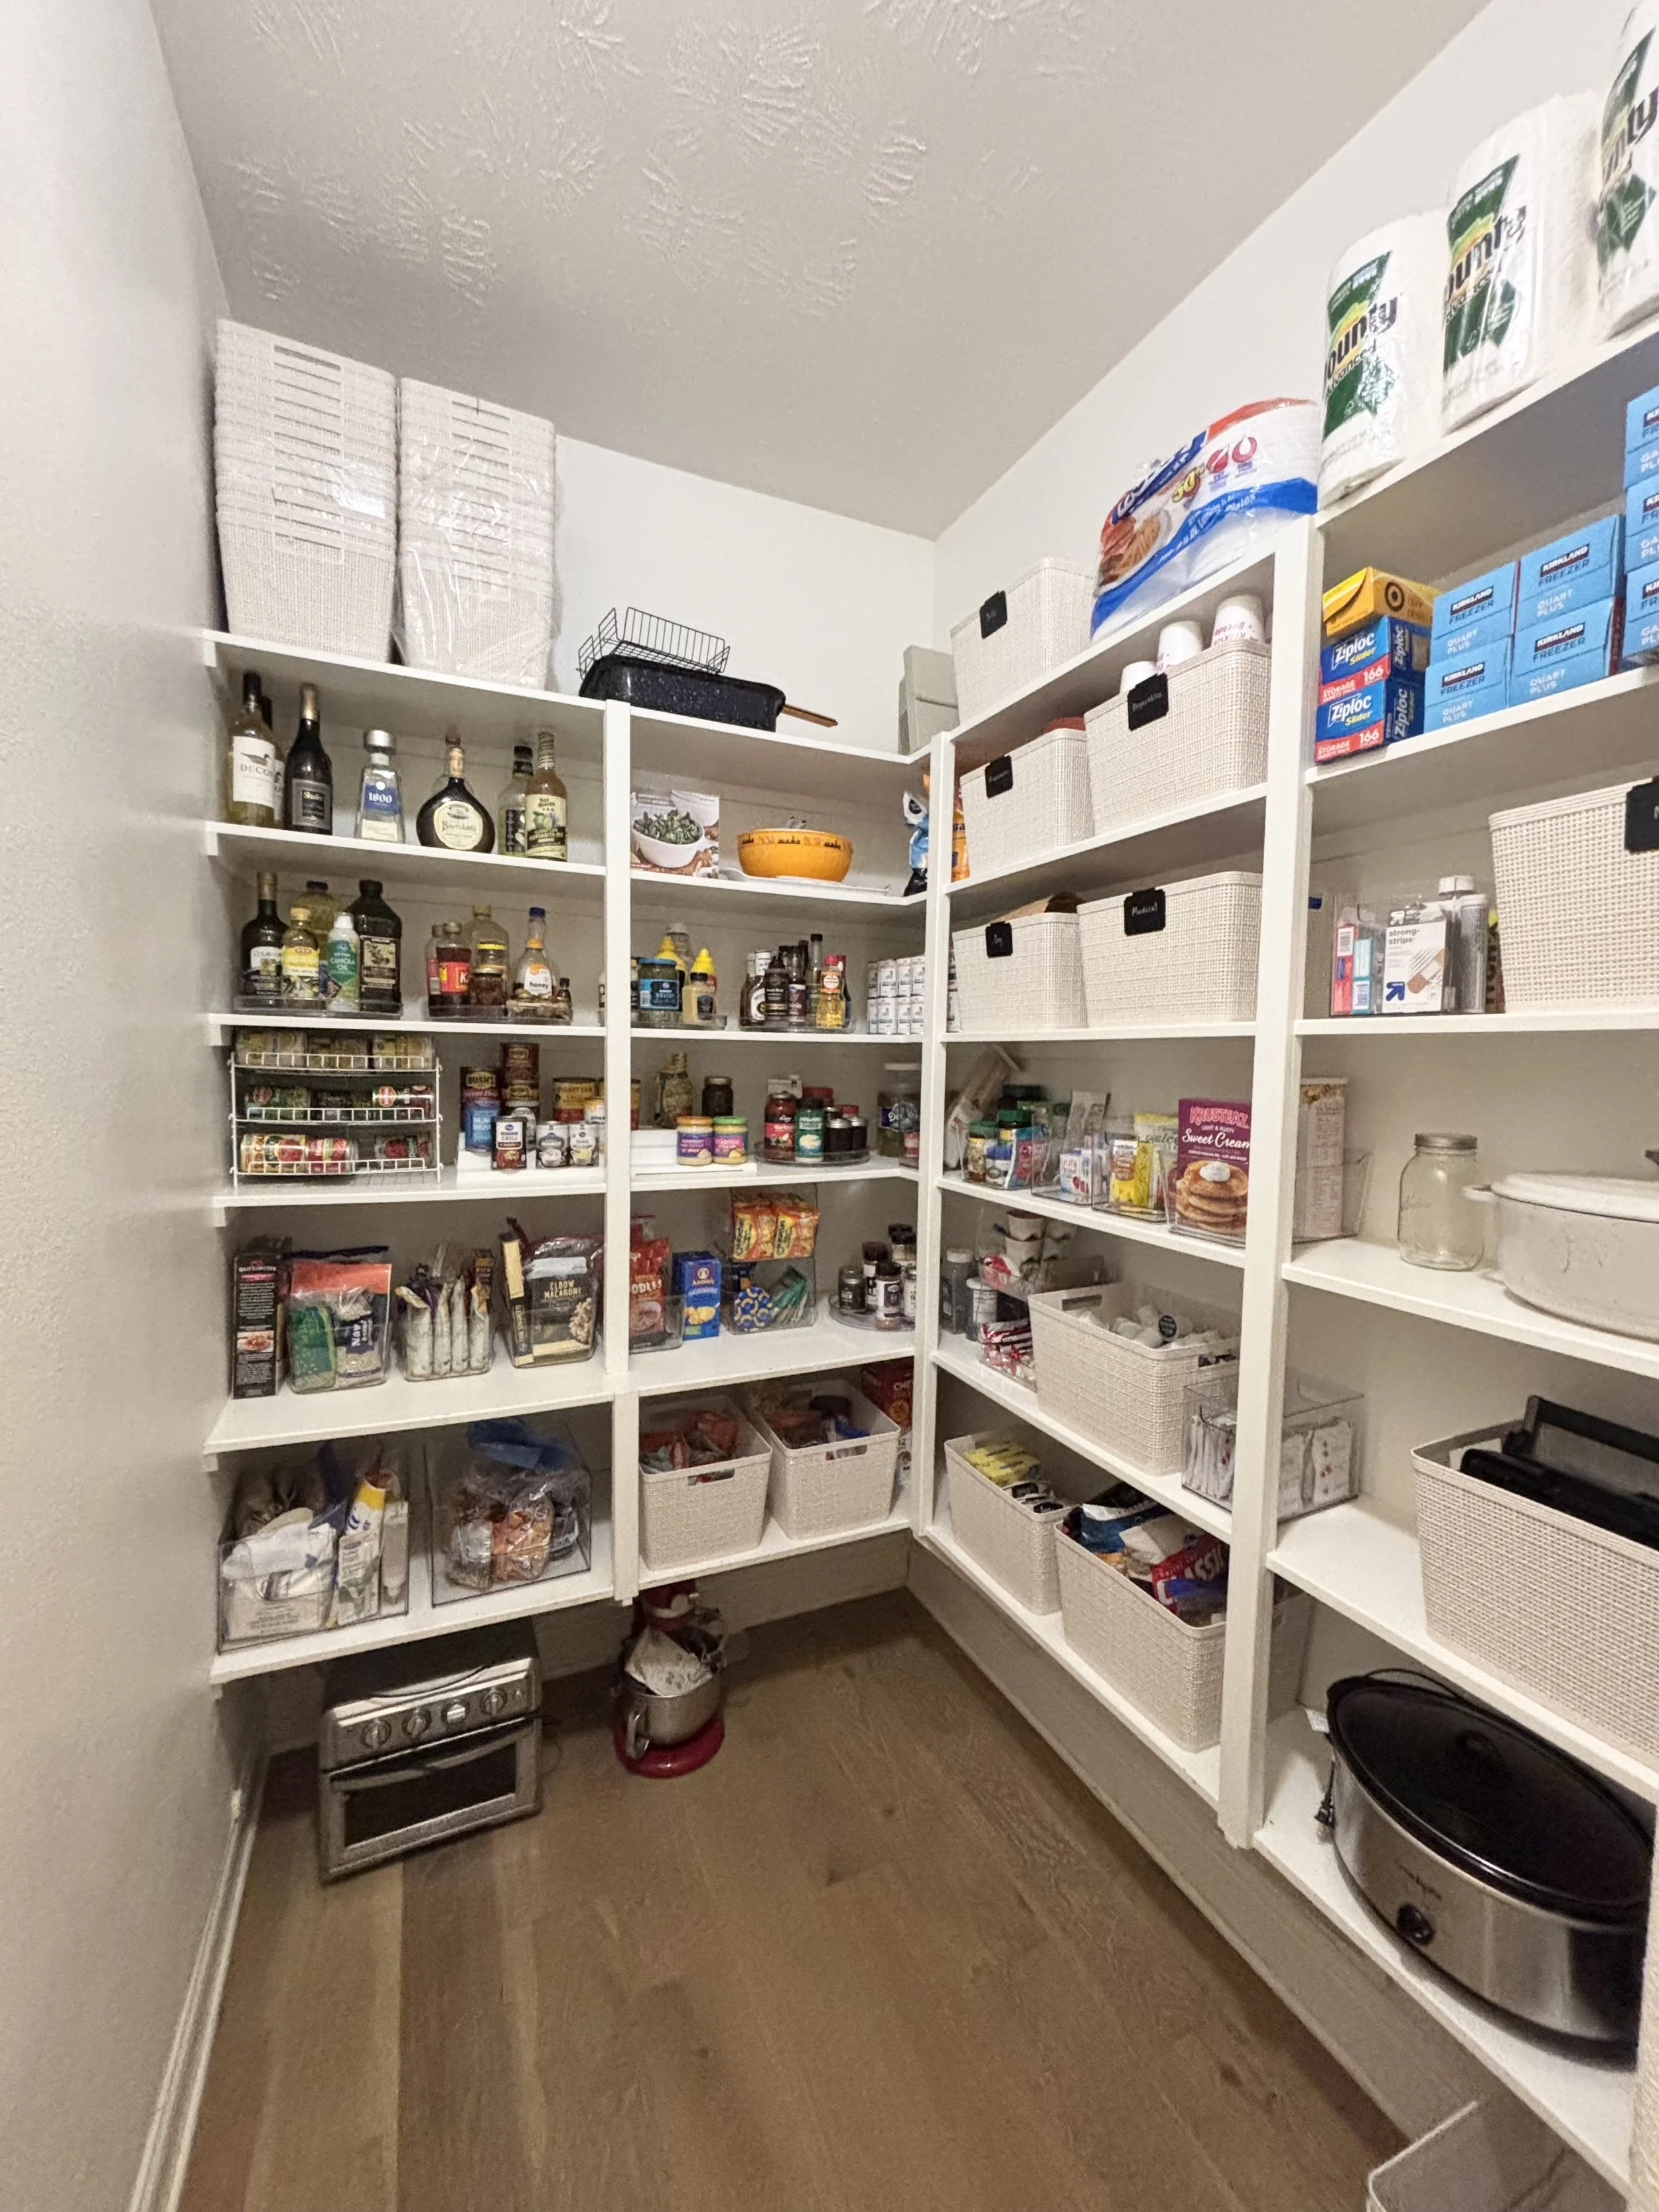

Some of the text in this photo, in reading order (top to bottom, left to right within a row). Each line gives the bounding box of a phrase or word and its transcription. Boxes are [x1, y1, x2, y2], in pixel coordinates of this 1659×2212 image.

[1542, 546, 1588, 571] KIRKLAND
[1538, 559, 1590, 587] FREEZER
[1452, 588, 1492, 611] KIRKLAND
[1537, 589, 1573, 609] QUART
[1449, 600, 1493, 625] FREEZER
[1537, 604, 1564, 617] PLUS
[1447, 628, 1478, 647] QUART
[1537, 625, 1584, 646] KIRKLAND
[1335, 632, 1375, 663] Ziploc
[1394, 625, 1406, 665] Ziploc
[1447, 640, 1471, 655] PLUS
[1533, 637, 1585, 662] FREEZER
[1350, 646, 1378, 666] Slider
[1363, 665, 1384, 682] 166
[1443, 664, 1484, 683] KIRKLAND
[1530, 669, 1566, 686] QUART
[1323, 680, 1355, 698] STORAGE
[1441, 676, 1485, 696] FREEZER
[1530, 681, 1557, 695] PLUS
[1331, 695, 1372, 722] Ziploc
[1394, 688, 1409, 738] Ziploc
[1443, 701, 1473, 716] QUART
[1443, 711, 1467, 723] PLUS
[1344, 710, 1373, 726] Slider
[1359, 729, 1380, 744] 166
[1318, 739, 1351, 755] STORAGE
[240, 764, 273, 778] DECOY
[368, 792, 393, 804] 1800
[1131, 901, 1158, 917] Medical
[530, 981, 549, 990] honey
[1190, 1106, 1250, 1129] KRUSTEAZ
[1182, 1128, 1214, 1145] Sweet
[1214, 1132, 1251, 1149] Cream
[543, 1287, 582, 1299] MACARONI
[549, 1280, 576, 1290] ELBOW
[631, 1280, 663, 1295] ODLES
